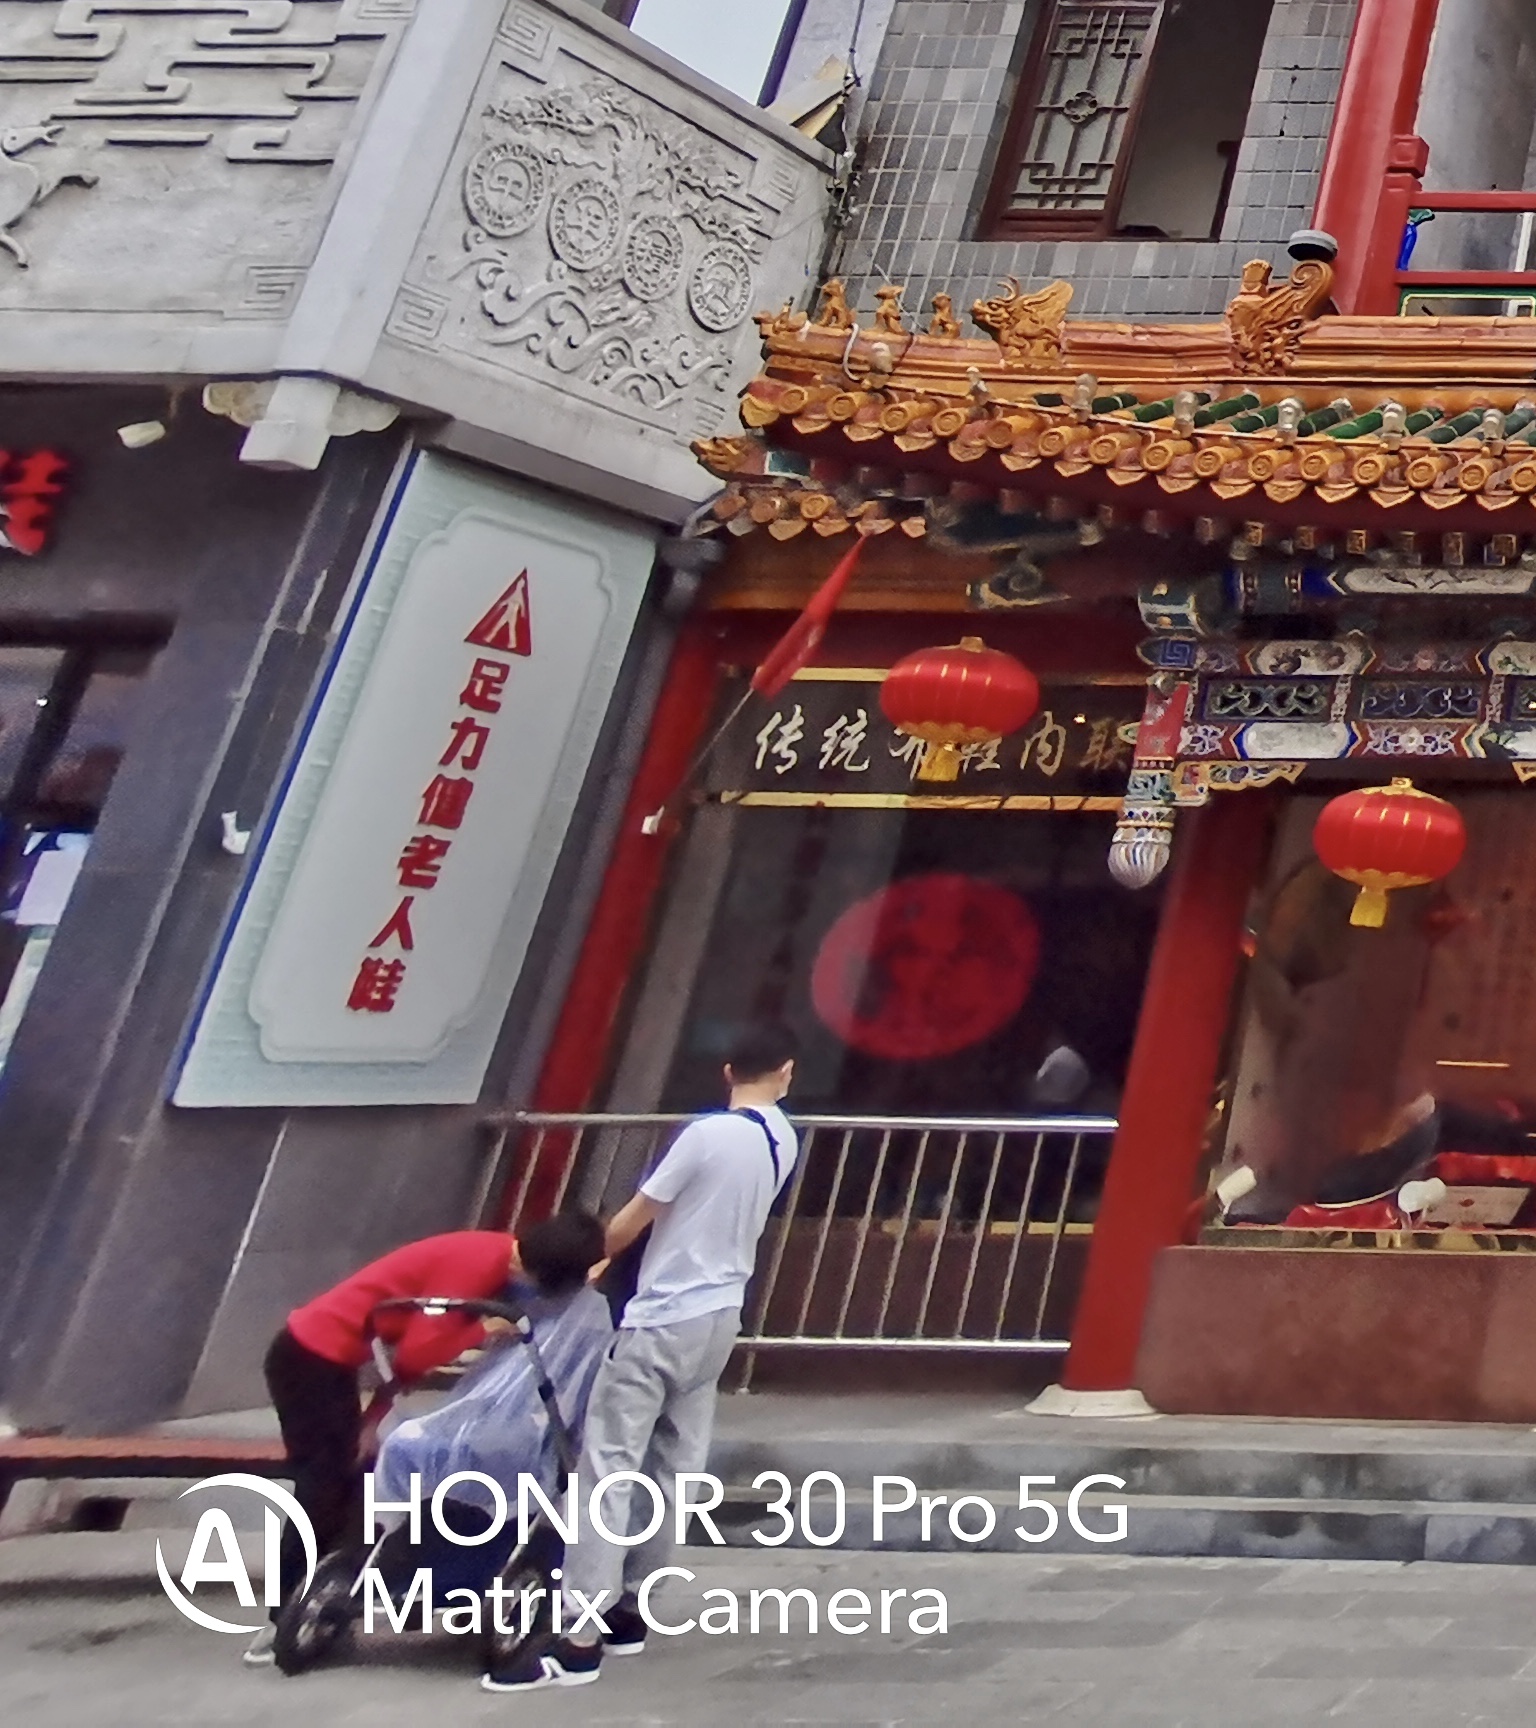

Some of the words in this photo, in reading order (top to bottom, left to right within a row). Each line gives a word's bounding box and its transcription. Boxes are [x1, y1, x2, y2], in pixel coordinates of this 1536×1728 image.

[345, 657, 512, 1014] 足力健老人鞋
